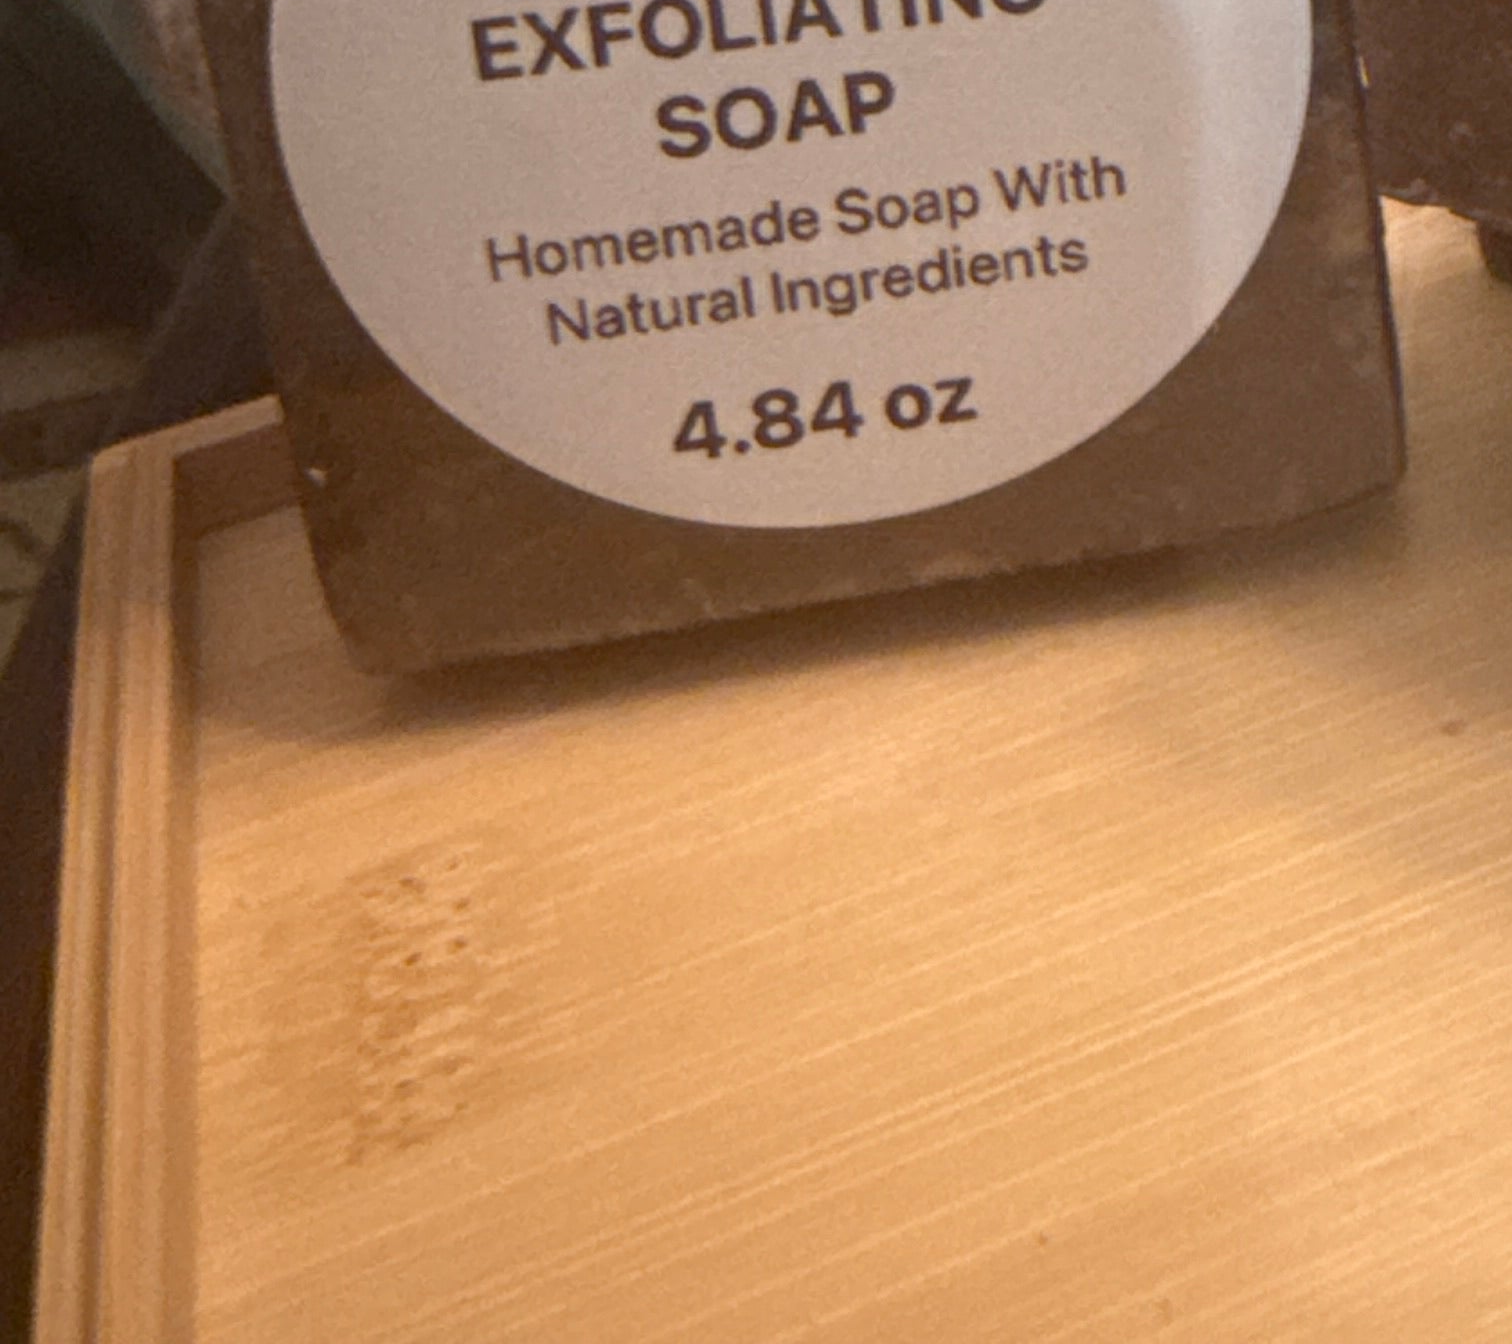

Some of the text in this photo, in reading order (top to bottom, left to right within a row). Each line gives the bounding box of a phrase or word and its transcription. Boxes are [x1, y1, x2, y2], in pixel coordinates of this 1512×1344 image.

[654, 69, 897, 160] SOAP
[485, 154, 1127, 283] Homemade Soap With
[545, 234, 1089, 347] Natural Ingredients
[671, 375, 979, 461] 4.84 oz
